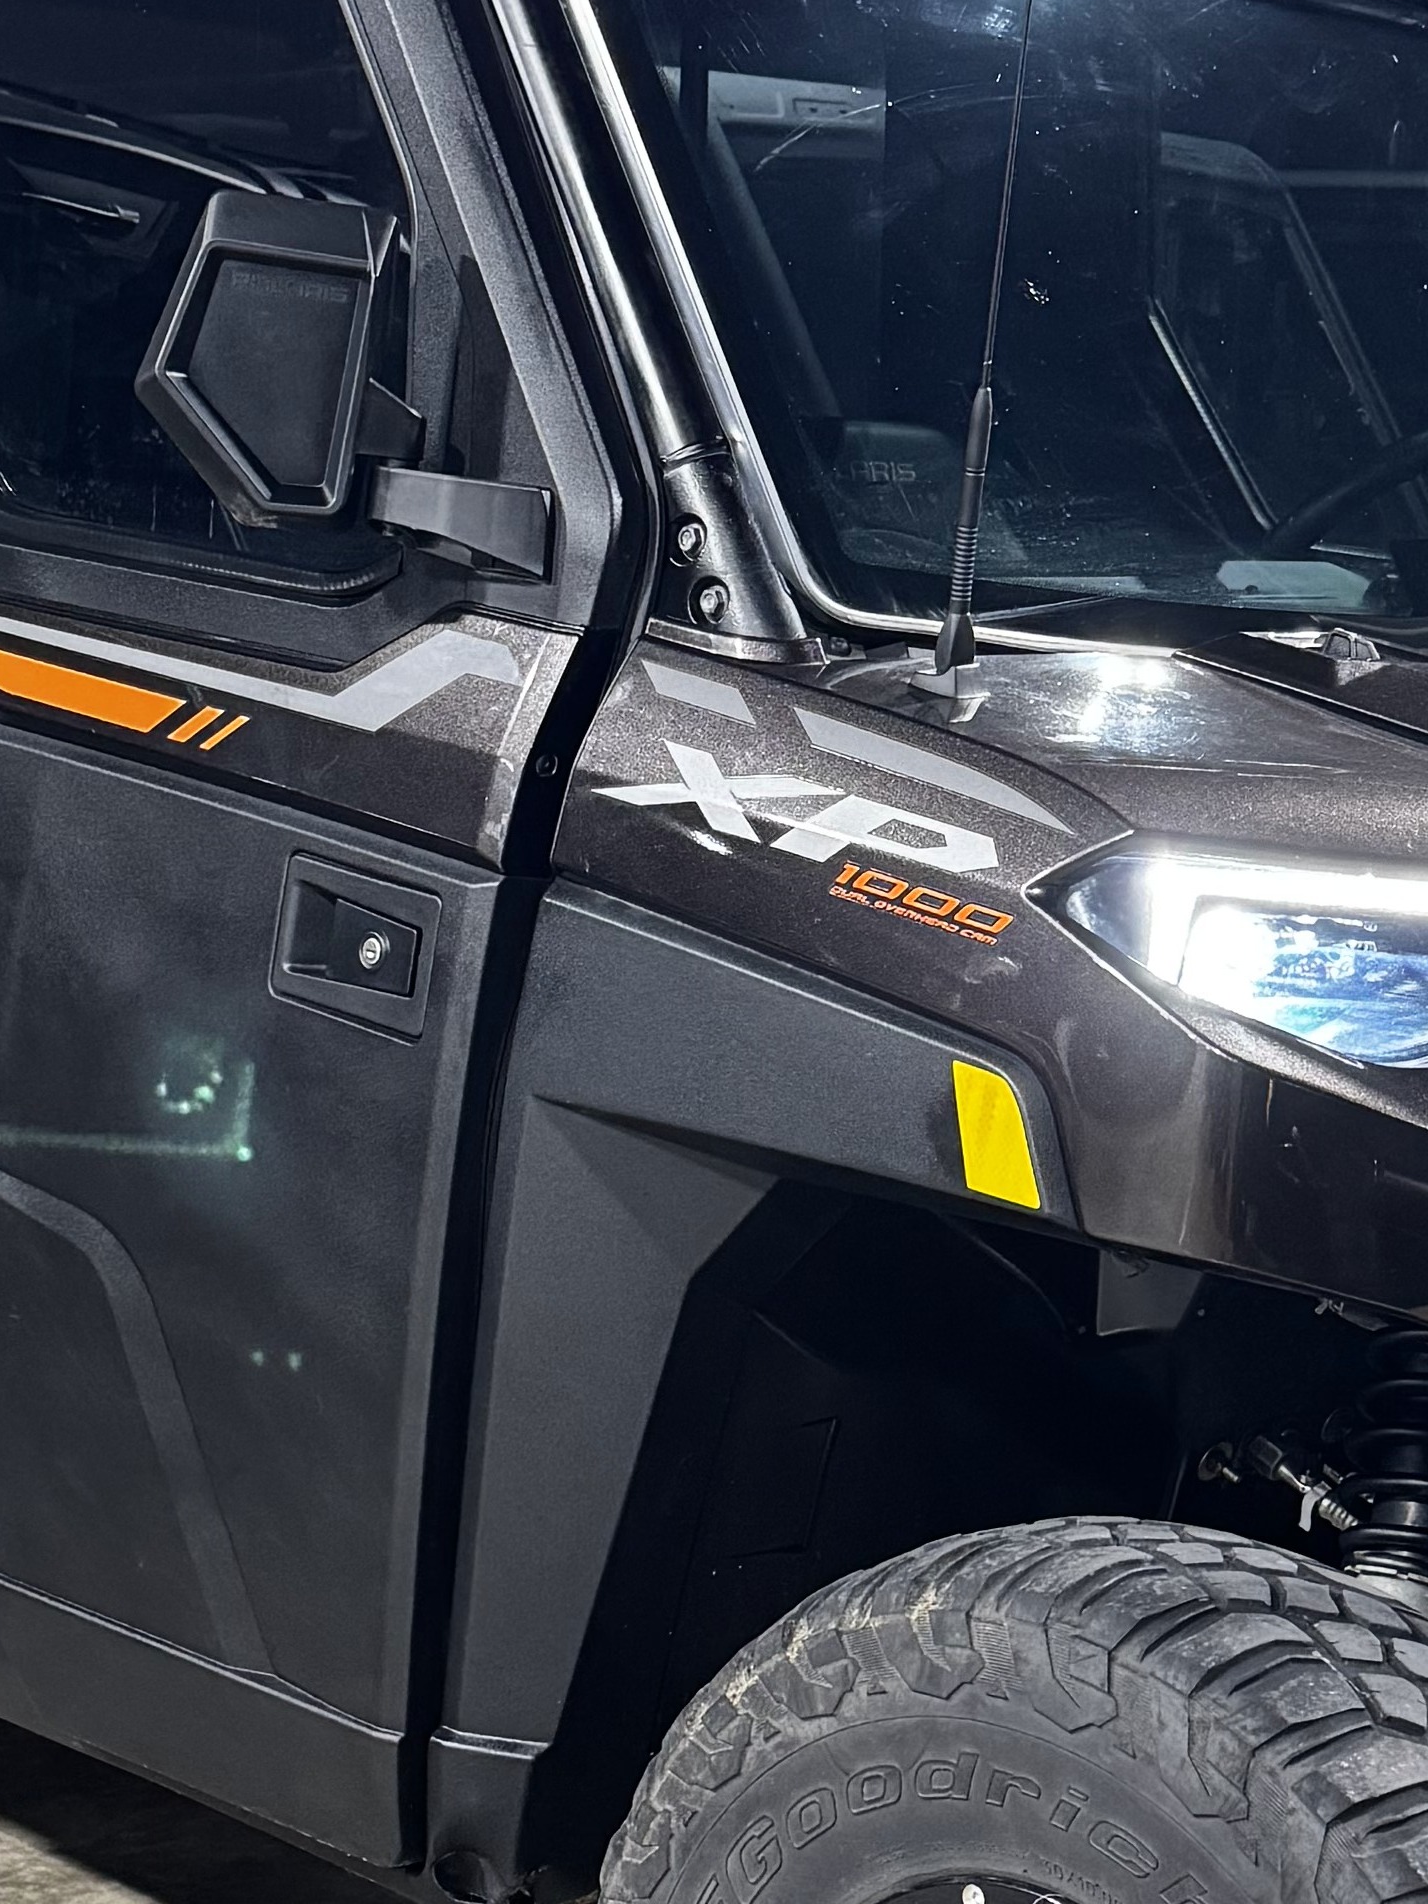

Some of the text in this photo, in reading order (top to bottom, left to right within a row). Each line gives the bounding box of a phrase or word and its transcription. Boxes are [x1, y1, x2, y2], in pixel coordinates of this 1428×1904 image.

[591, 738, 999, 874] XP
[834, 862, 1015, 934] 1000
[959, 928, 999, 946] CAM
